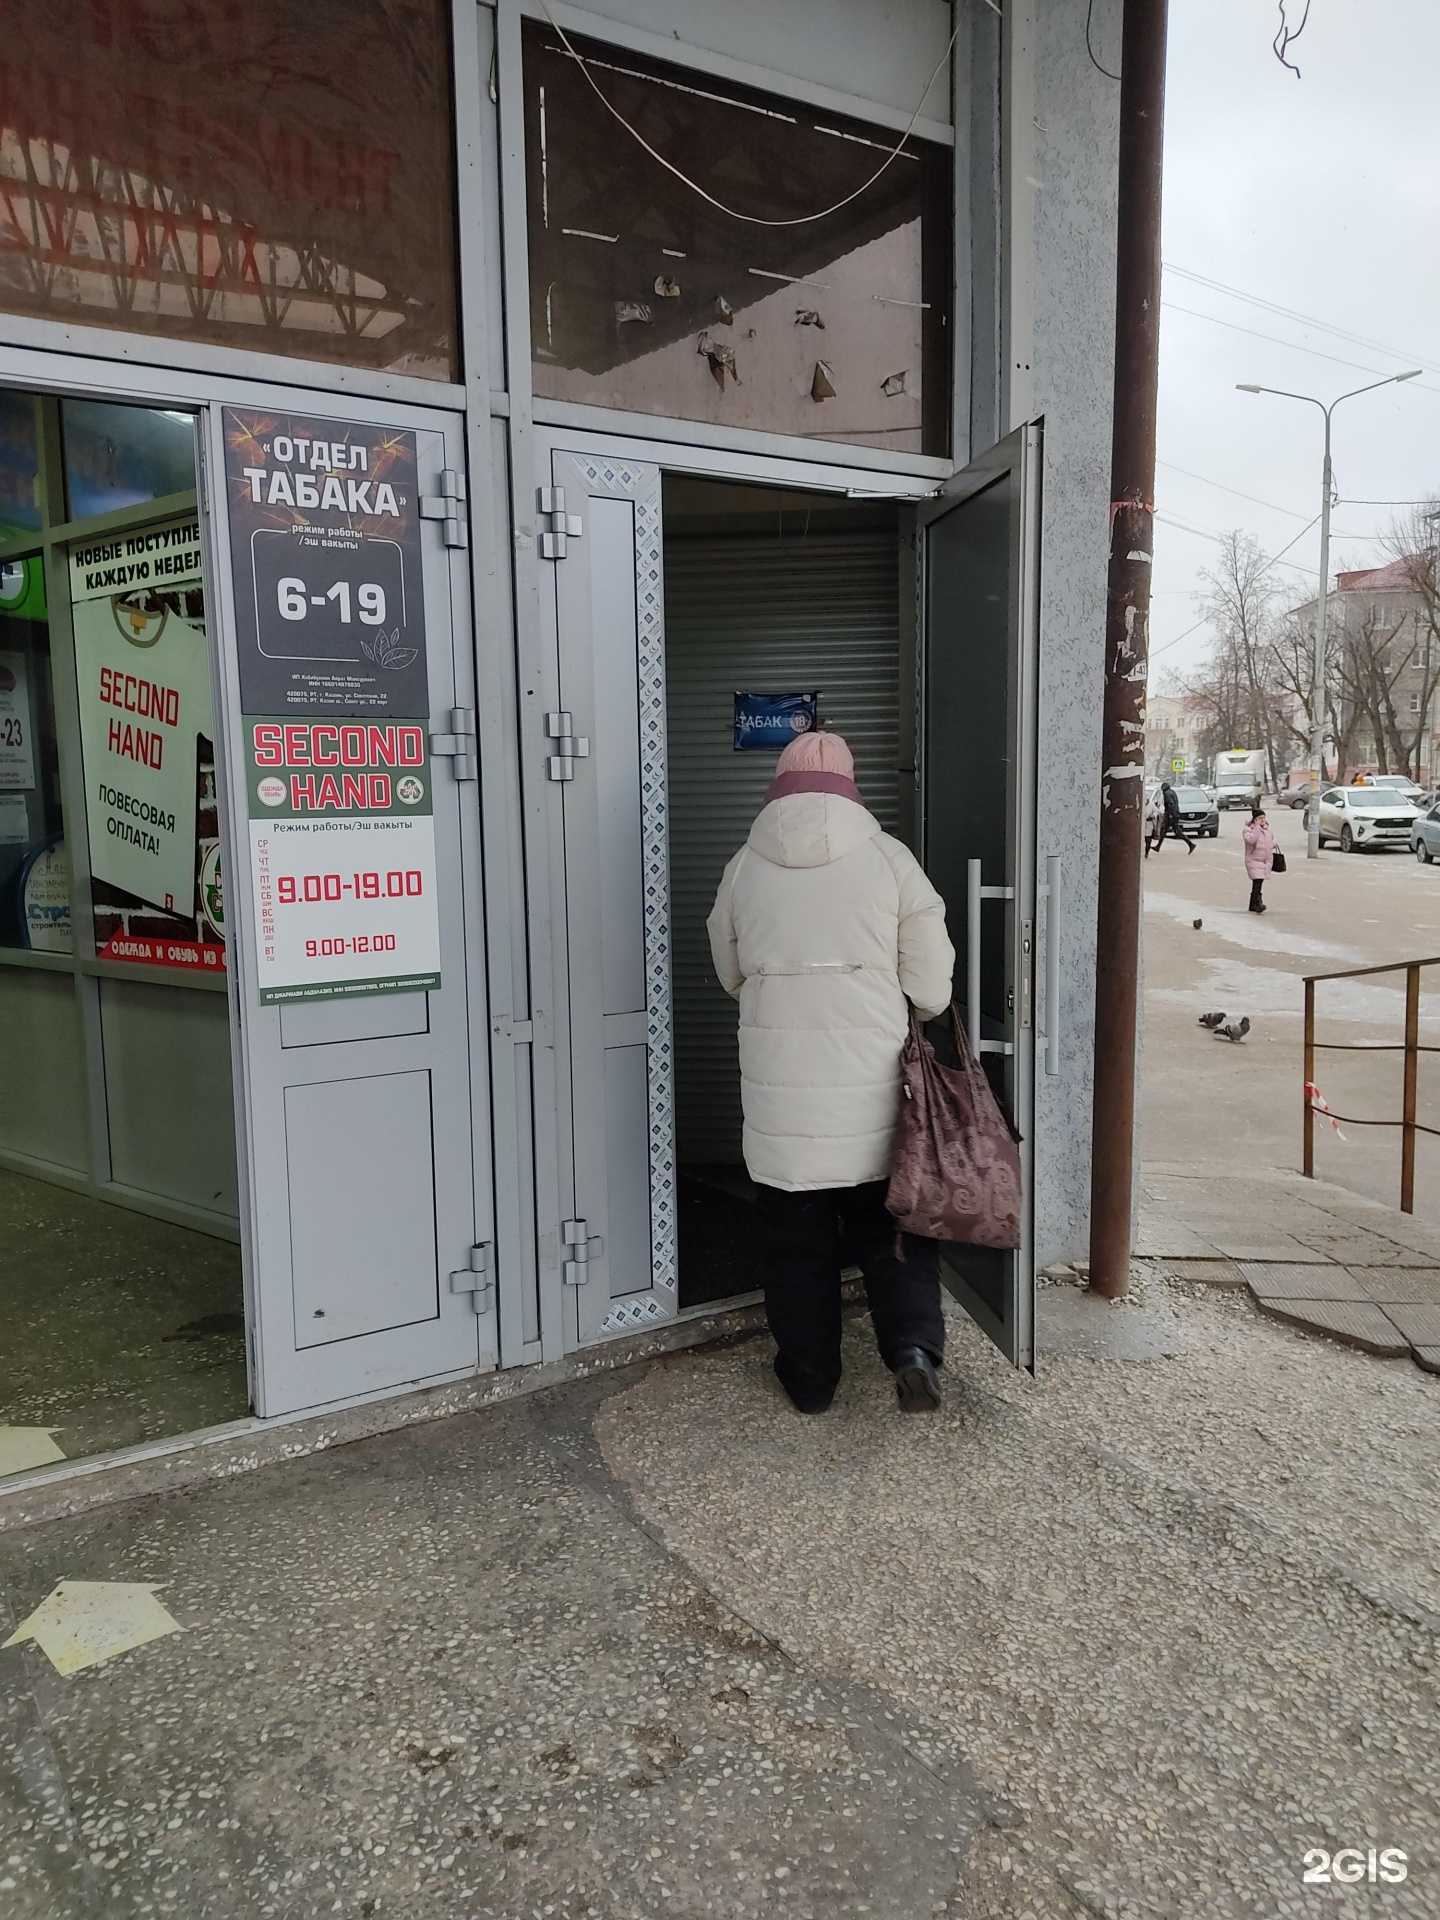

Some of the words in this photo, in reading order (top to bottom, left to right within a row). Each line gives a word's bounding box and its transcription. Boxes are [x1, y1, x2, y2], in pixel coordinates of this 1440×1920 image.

[243, 467, 407, 517] ТАБАКА»
[292, 525, 325, 535] режим
[328, 527, 363, 539] работы
[75, 541, 122, 567] НОВЫЕ
[126, 523, 200, 556] ПОСТУПЛЕ
[322, 539, 358, 550] вакыты
[86, 562, 149, 590] КАЖДУЮ
[277, 577, 386, 625] 6-19
[99, 667, 179, 727] SECOND
[738, 714, 782, 728] ТАБАК
[108, 718, 163, 770] HAND
[253, 723, 424, 767] SECOND
[290, 772, 392, 810] HAND
[99, 784, 175, 833] ПОВЕСОВАЯ
[107, 817, 160, 856] ОПЛАТА!
[273, 823, 310, 832] Режим
[312, 821, 372, 832] работы/Эш
[374, 821, 413, 831] вакыты
[257, 839, 268, 848] СР
[258, 857, 269, 865] ЧТ
[260, 875, 269, 883] ПТ
[277, 870, 423, 904] 9.00-19.00
[261, 891, 272, 900] СБ
[262, 908, 273, 917] ВС
[263, 925, 274, 934] ПН
[111, 941, 151, 958] ОДЕЖДА
[156, 945, 163, 960] И
[264, 946, 274, 955] ВТ
[305, 934, 396, 957] 9.00-12.00
